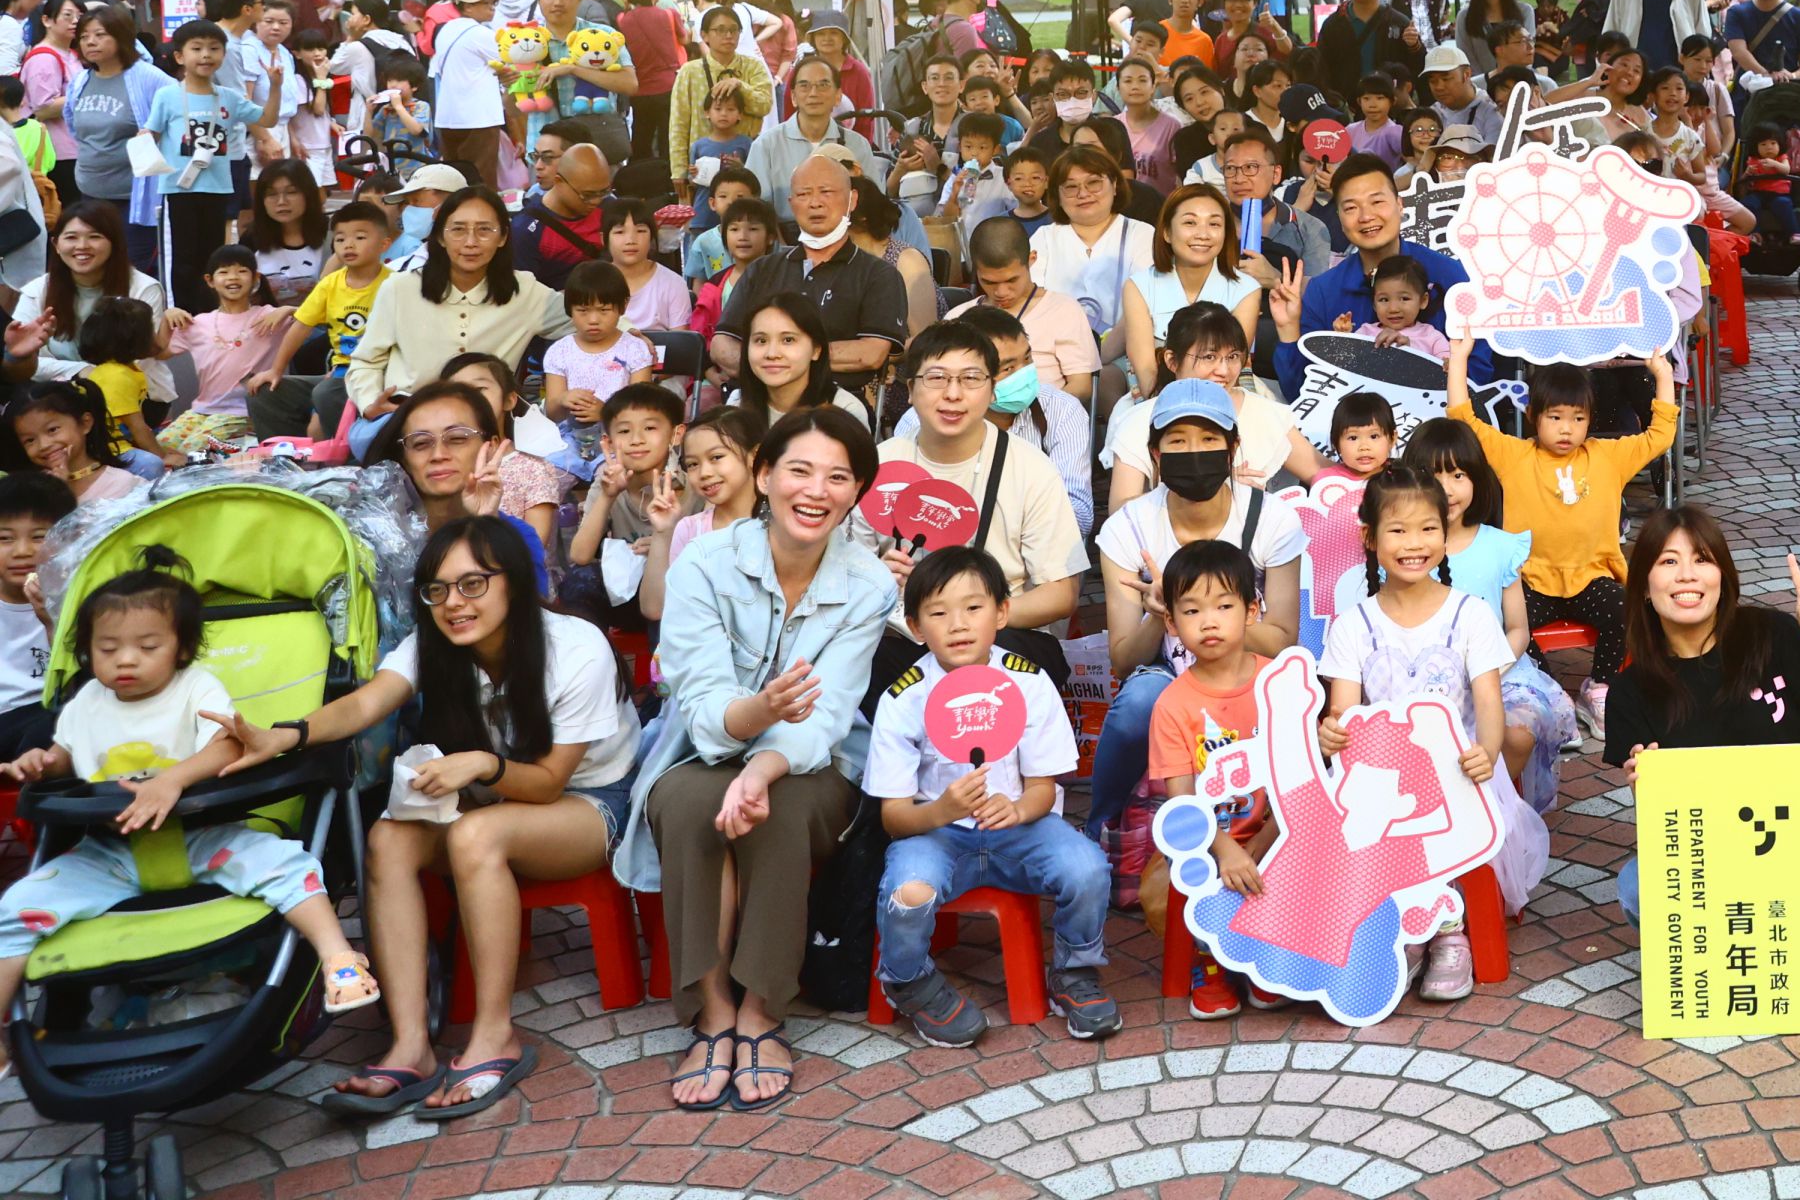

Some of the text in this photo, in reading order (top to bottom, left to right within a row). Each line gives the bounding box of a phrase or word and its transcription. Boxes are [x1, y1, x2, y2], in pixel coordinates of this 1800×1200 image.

[1665, 809, 1684, 1019] TAIPEI CITY GOVERNMENT
[1689, 808, 1709, 1019] DEPARTMENT FOR YOUTH
[1725, 901, 1759, 1017] 青年局
[1768, 900, 1790, 1015] 臺北市政府
